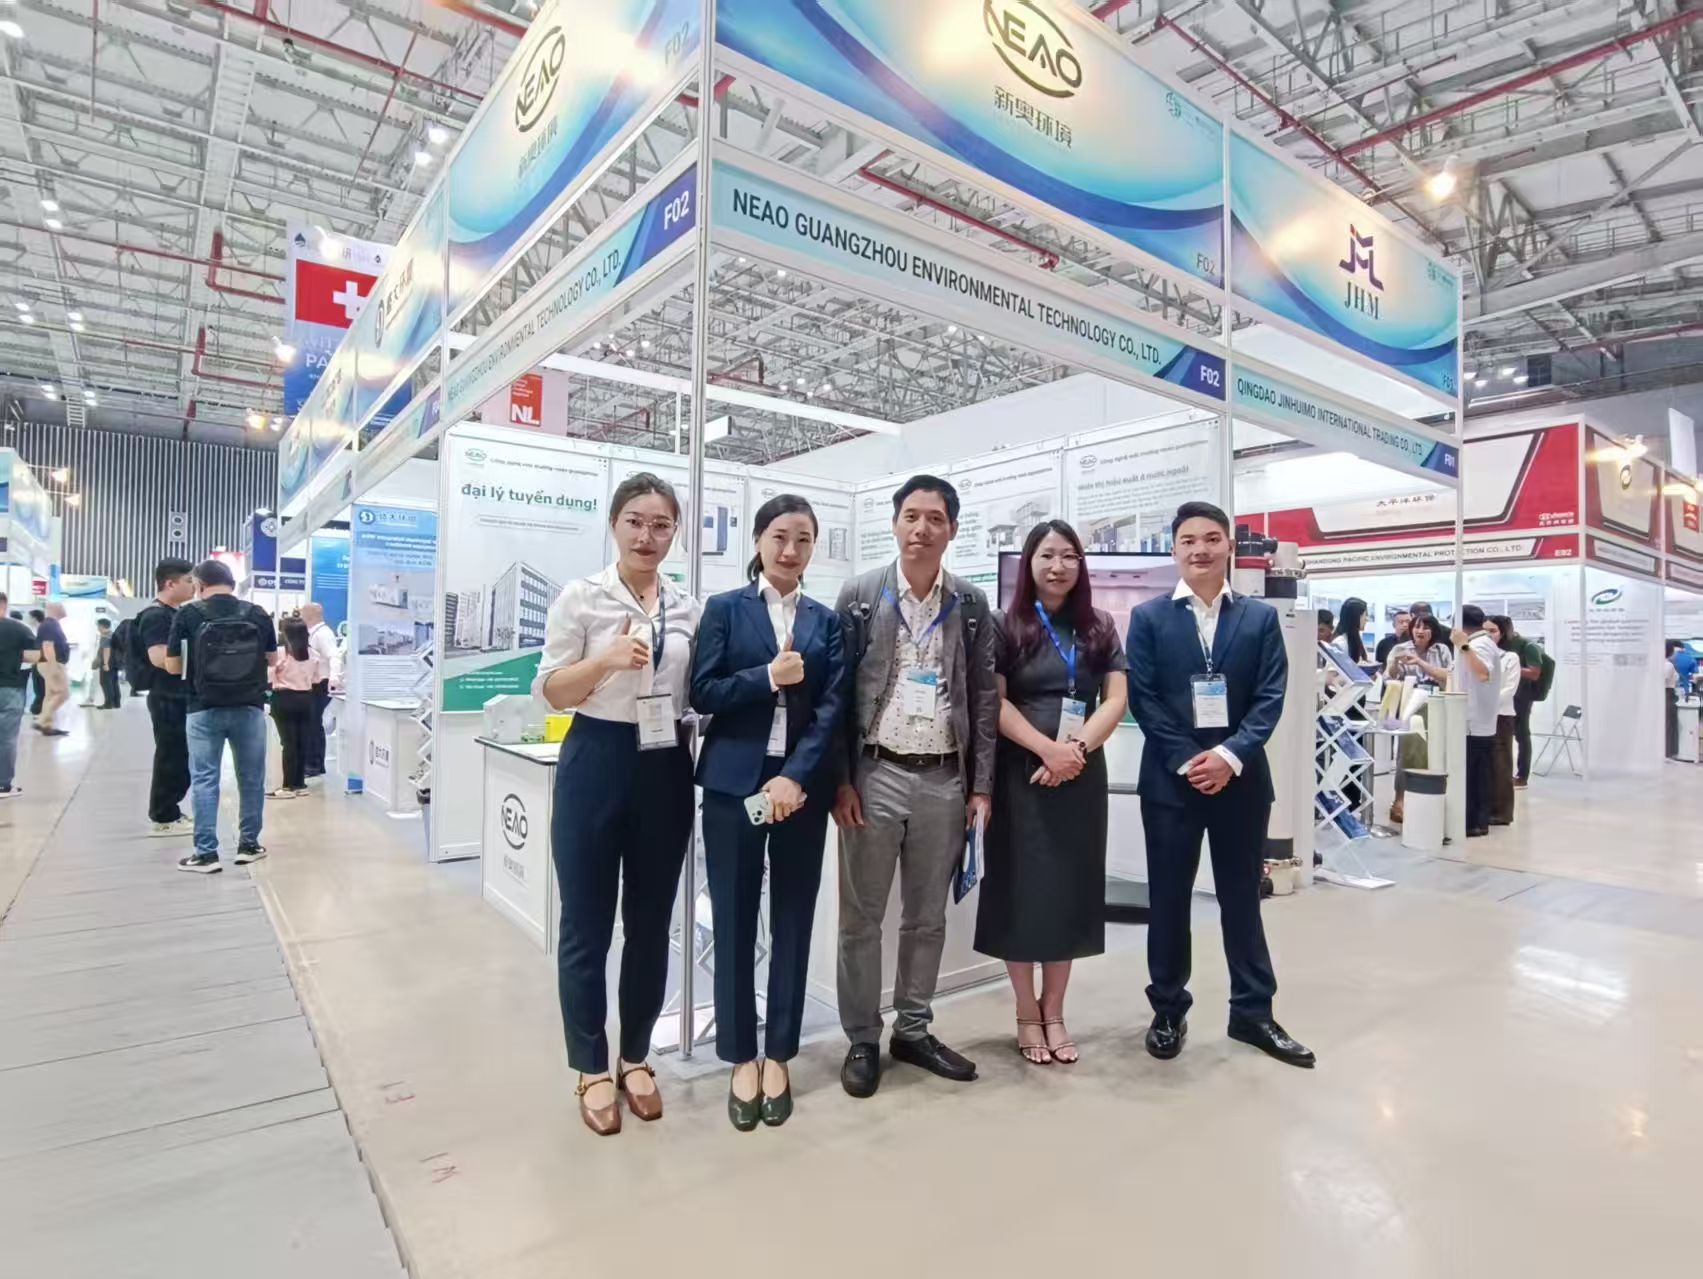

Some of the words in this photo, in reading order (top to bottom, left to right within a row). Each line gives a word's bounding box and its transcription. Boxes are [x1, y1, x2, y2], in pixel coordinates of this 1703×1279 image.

[664, 23, 690, 65] F02
[983, 0, 1082, 89] NEAO
[515, 33, 566, 126] NEAO
[663, 190, 690, 231] F02
[733, 188, 789, 229] NEAO
[795, 212, 908, 272] GUANGZHOU
[913, 256, 1035, 319] ENVIRONMENTAL
[1037, 303, 1117, 349] TECHNOLOGY
[1118, 334, 1139, 360] CO.,
[1141, 342, 1162, 365] LTD.
[1196, 252, 1217, 276] F02
[536, 277, 584, 329] TECHNOLOGY
[603, 249, 622, 278] LTD.
[1200, 365, 1220, 387] F02
[1237, 377, 1276, 407] QINGDAO
[1277, 394, 1316, 418] JINHUIMO
[1317, 407, 1371, 438] INTERNATIONAL
[1371, 427, 1400, 448] TRADING
[461, 482, 486, 499] đại
[491, 486, 505, 502] lý
[556, 494, 598, 512] dụng!
[500, 804, 528, 840] NEAO
